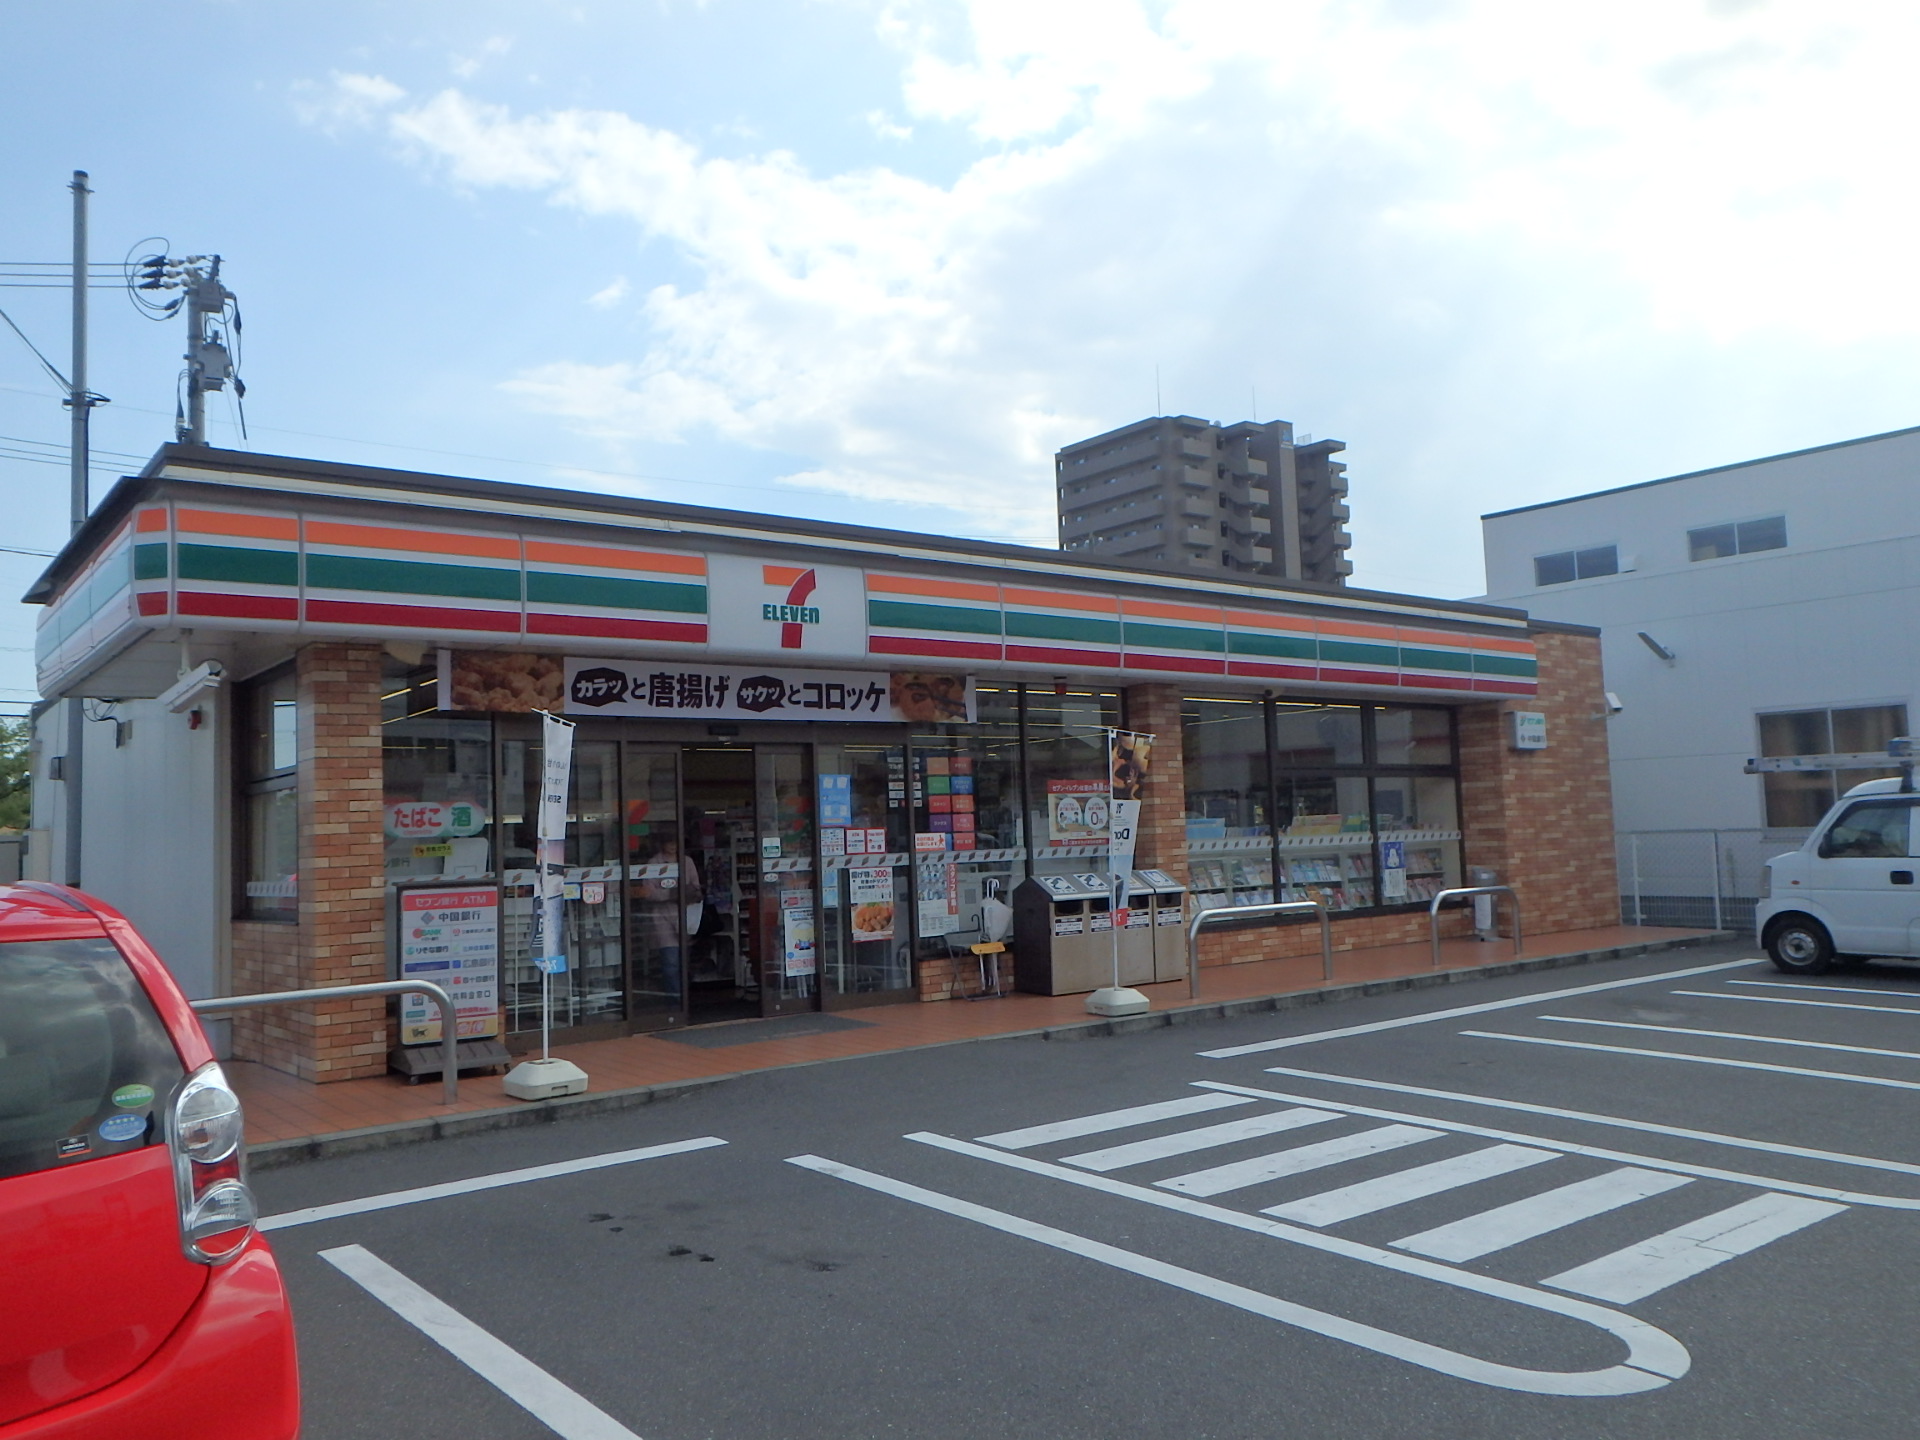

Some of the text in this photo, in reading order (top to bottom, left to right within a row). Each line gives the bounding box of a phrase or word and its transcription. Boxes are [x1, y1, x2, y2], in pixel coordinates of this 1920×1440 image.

[575, 671, 886, 713] カラッと唐揚げ サクッとコロッケ
[394, 806, 472, 829] たばこ 酒
[415, 895, 487, 907] セブン銀行 ATM
[438, 909, 482, 922] 中国銀行
